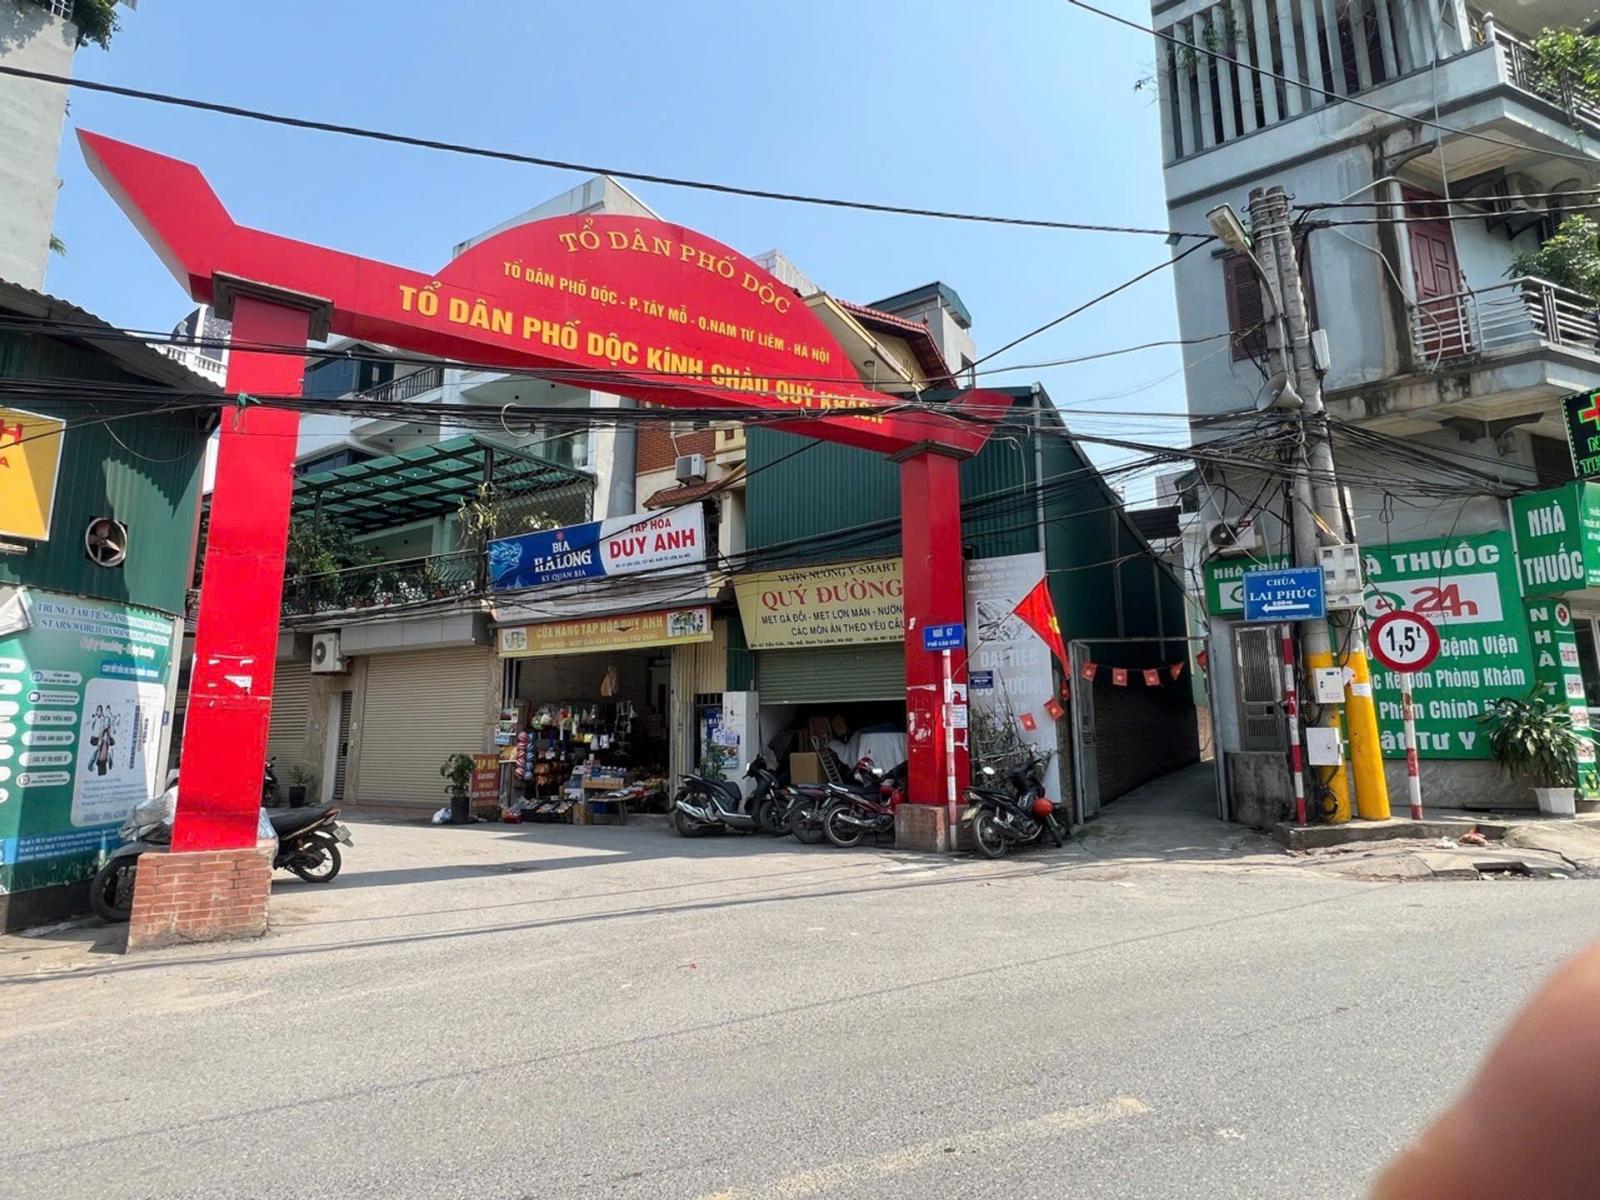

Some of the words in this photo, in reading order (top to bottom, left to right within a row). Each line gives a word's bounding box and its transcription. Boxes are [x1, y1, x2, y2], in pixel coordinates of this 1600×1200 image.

[558, 218, 601, 253] TỔ
[607, 229, 671, 257] DÂN
[680, 245, 737, 279] PHỐ
[742, 272, 791, 314] DỘC
[503, 258, 523, 279] TỔ
[525, 268, 554, 288] DÂN
[559, 279, 587, 297] PHỐ
[590, 286, 618, 306] DỘC
[668, 304, 688, 324] MỖ
[758, 333, 785, 351] LIÊM
[399, 281, 443, 318] TỔ
[448, 298, 514, 336] DÂN
[522, 317, 582, 351] PHỐ
[587, 332, 639, 367] DỘC
[646, 346, 703, 381] KÍNH
[776, 379, 815, 408] QUÝ
[1527, 500, 1567, 538] NHÀ
[552, 541, 571, 553] BIA
[609, 536, 647, 560] DUY
[654, 528, 696, 553] ANH
[848, 562, 897, 576] V-SMART
[1523, 542, 1585, 586] THUỐC
[1249, 591, 1272, 601] LAI
[1277, 586, 1317, 600] PHÚC
[1266, 576, 1296, 587] CHÙA
[761, 584, 808, 612] QUÝ
[816, 578, 903, 604] ĐƯỜNG
[1411, 583, 1478, 617] 24h
[780, 613, 791, 624] GÀ
[878, 604, 904, 615] NƯỚN
[791, 625, 808, 636] CÁC
[844, 622, 867, 633] THEO
[869, 619, 886, 631] YÊU
[1441, 638, 1479, 660] Bệnh
[1482, 634, 1519, 658] Viện
[1436, 667, 1480, 691] Phòng
[1483, 665, 1525, 686] Khám
[1429, 699, 1479, 720] Chính
[1381, 730, 1406, 754] ật
[1416, 731, 1449, 750] Tư
[1458, 731, 1476, 750] Y
